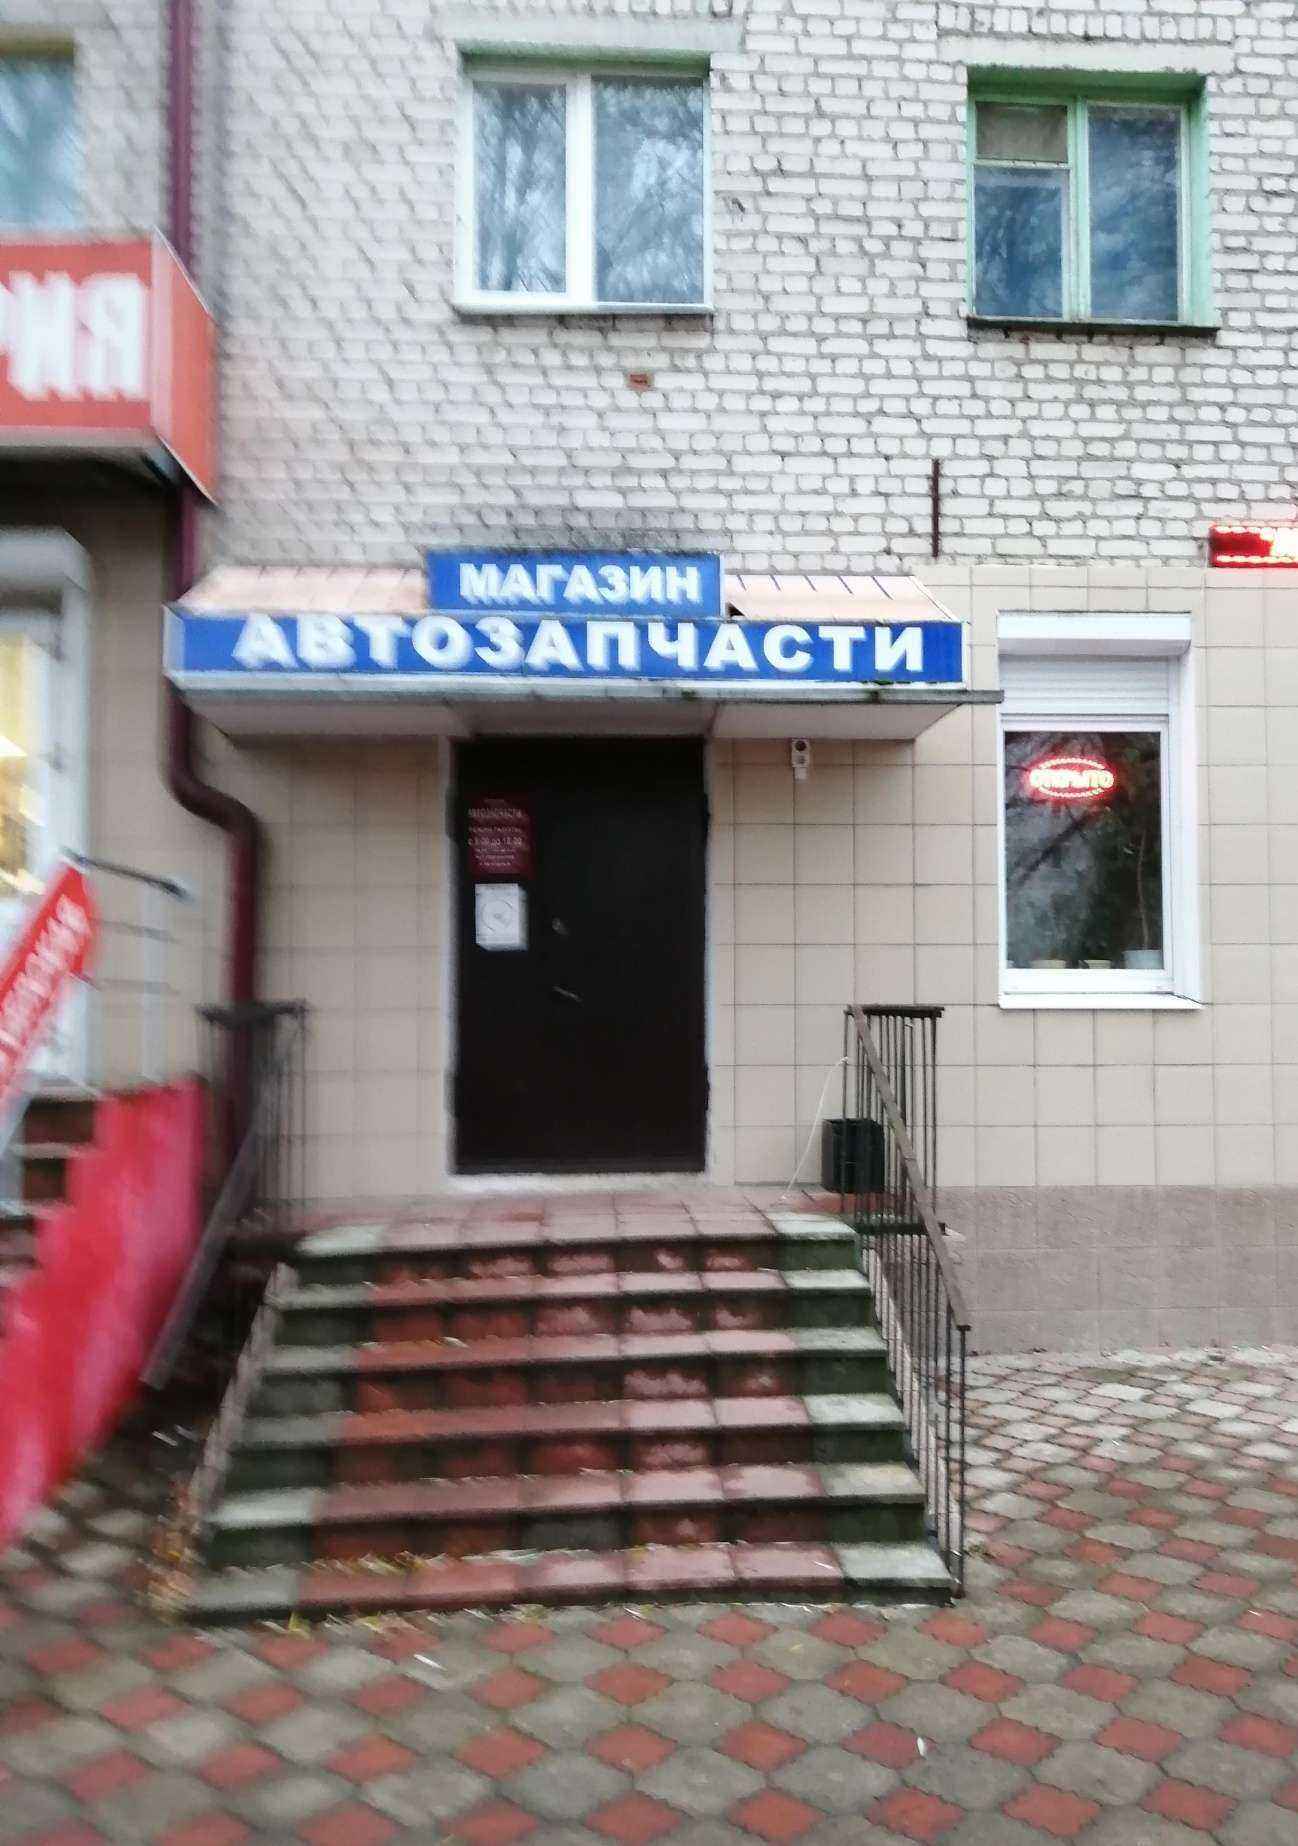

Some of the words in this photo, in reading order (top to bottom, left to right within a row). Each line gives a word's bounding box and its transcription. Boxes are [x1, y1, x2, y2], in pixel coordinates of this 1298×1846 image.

[0, 270, 149, 400] ИЯ
[458, 563, 703, 605] МАГАЗИН
[231, 613, 925, 674] АВТОЗАПЧАСТИ
